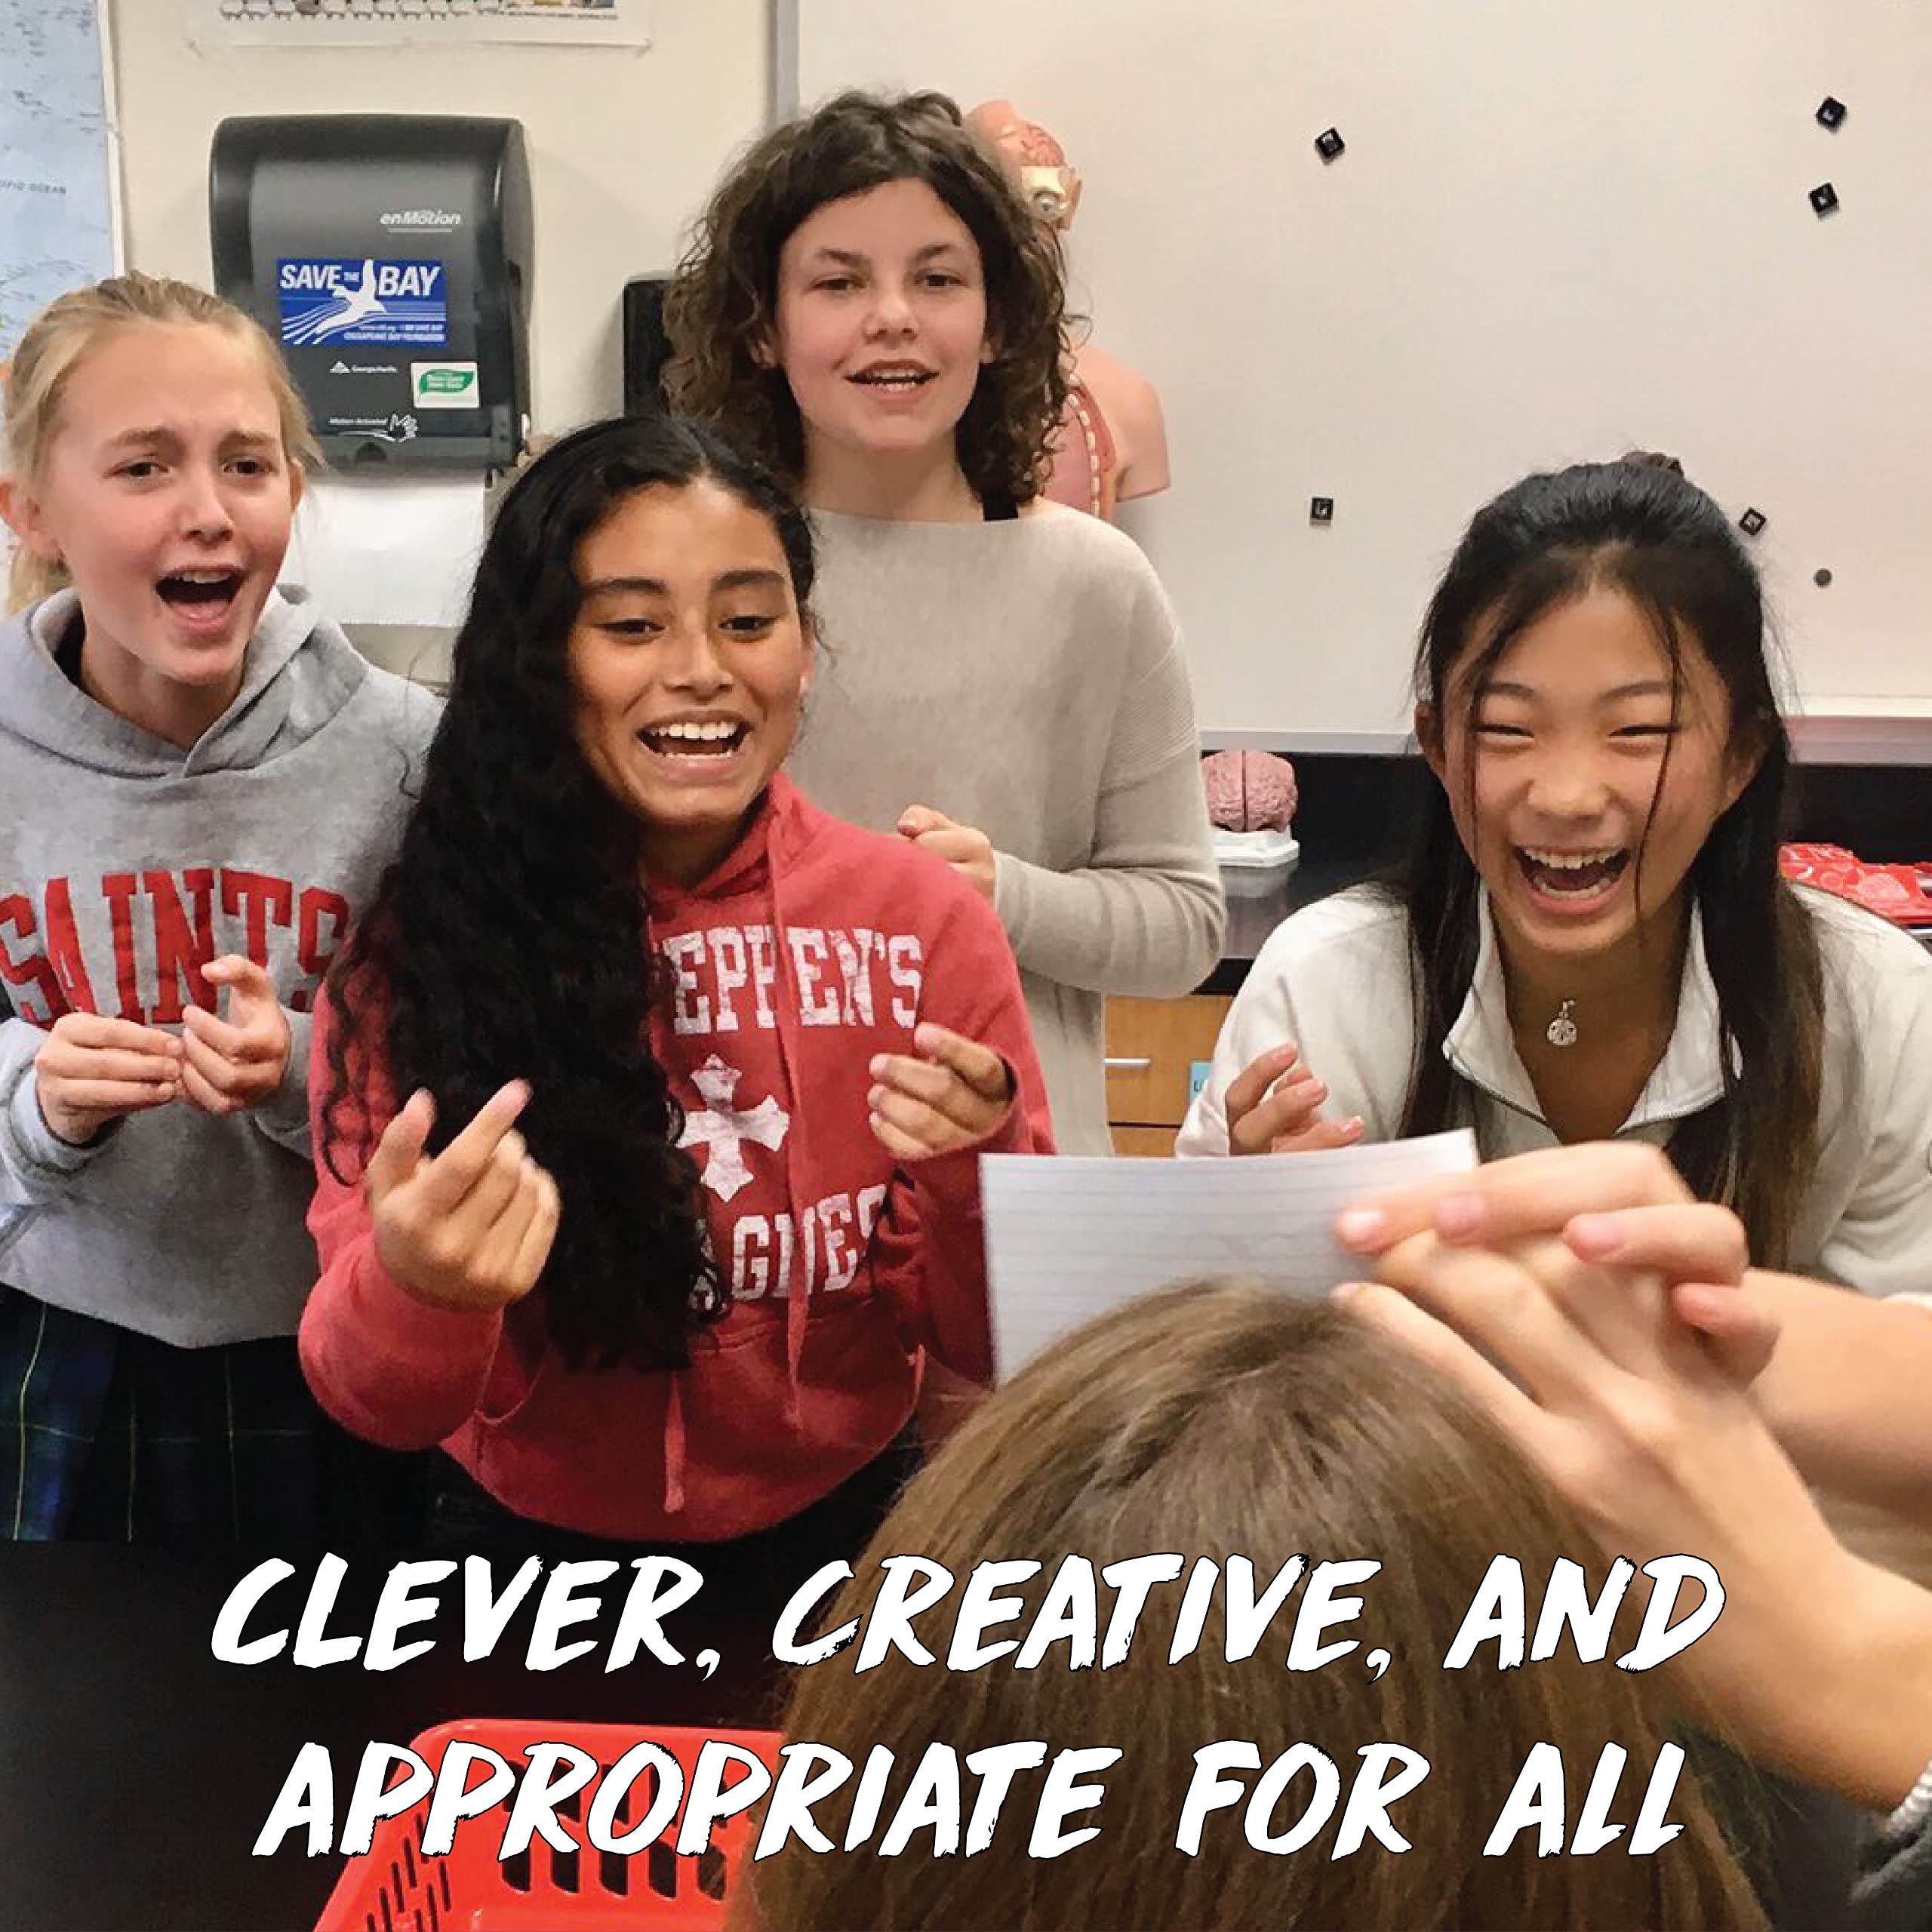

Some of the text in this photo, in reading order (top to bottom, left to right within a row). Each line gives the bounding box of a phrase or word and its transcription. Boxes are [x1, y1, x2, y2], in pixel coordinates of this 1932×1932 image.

[380, 210, 460, 225] enMotion
[280, 264, 343, 289] SAVE
[378, 266, 441, 296] BAY
[655, 923, 923, 1035] EPHEN'S
